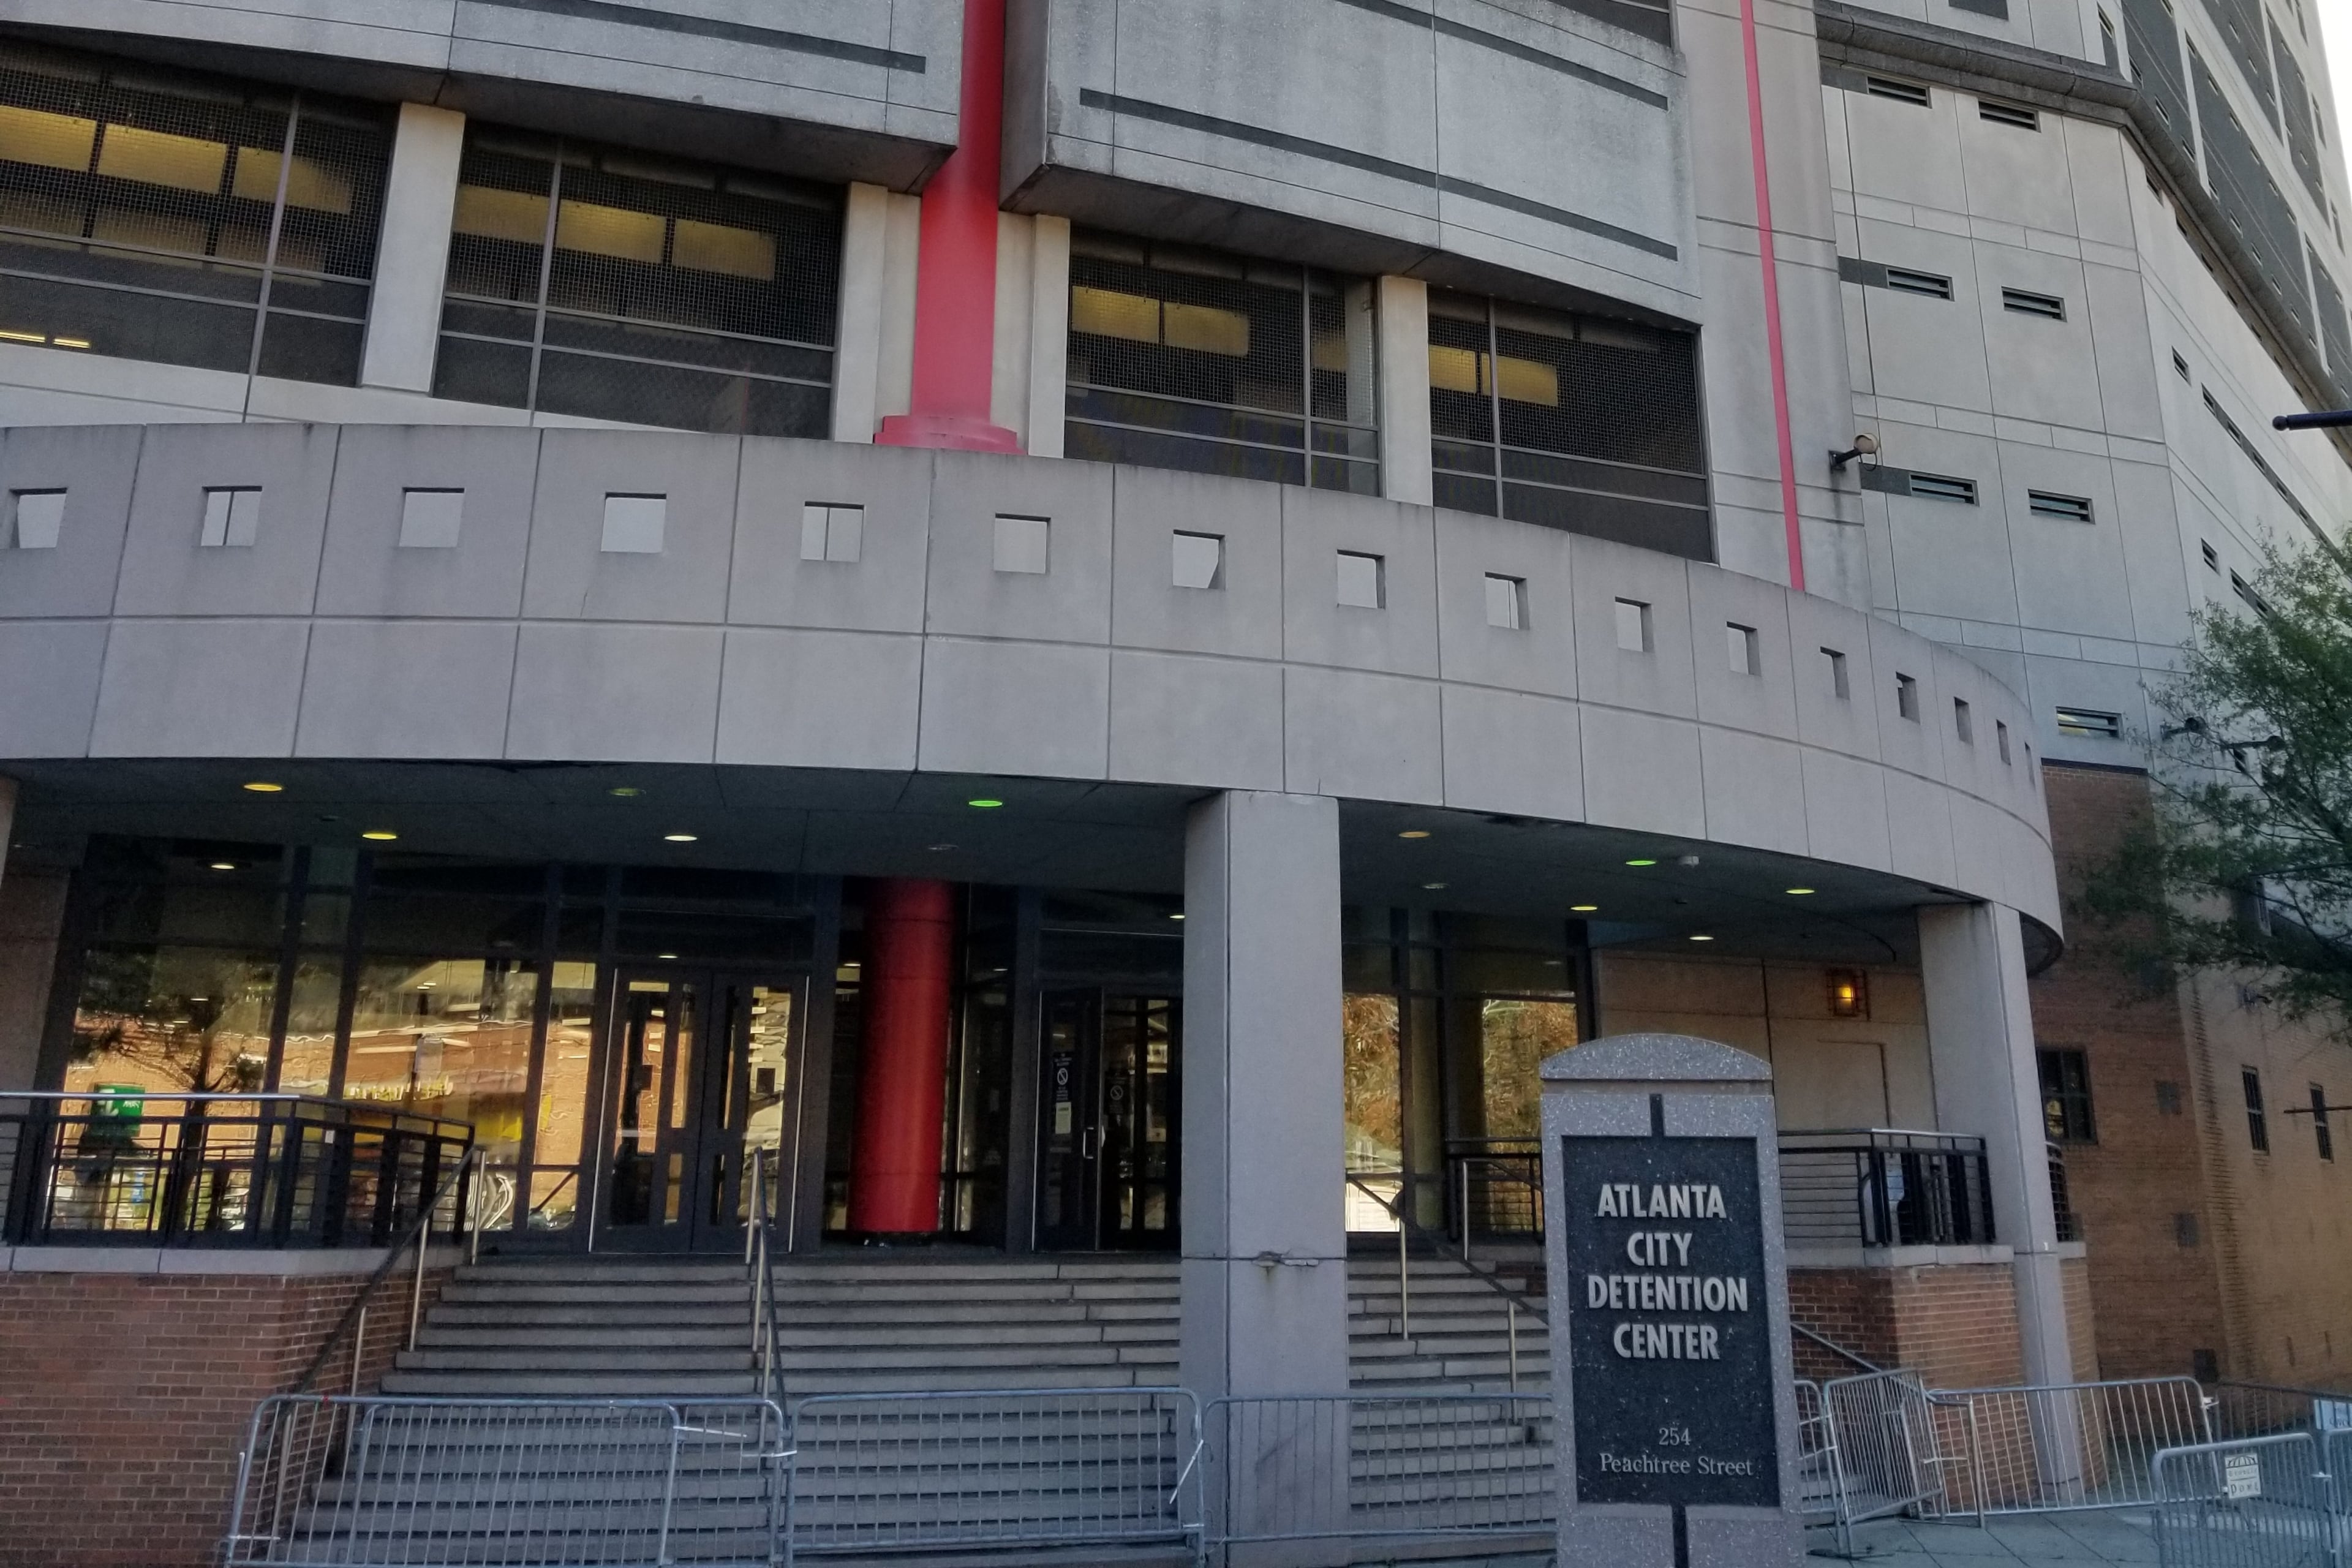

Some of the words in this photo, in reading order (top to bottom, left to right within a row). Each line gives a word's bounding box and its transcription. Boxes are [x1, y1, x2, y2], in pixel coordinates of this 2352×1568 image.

[1597, 1184, 1727, 1218] ATLANTA
[1627, 1232, 1692, 1266] CITY
[1588, 1275, 1747, 1311] DETENTION
[1613, 1324, 1720, 1359] CENTER
[1659, 1428, 1691, 1446] 254
[1599, 1453, 1691, 1474] Peachtree
[1698, 1456, 1754, 1476] Street
